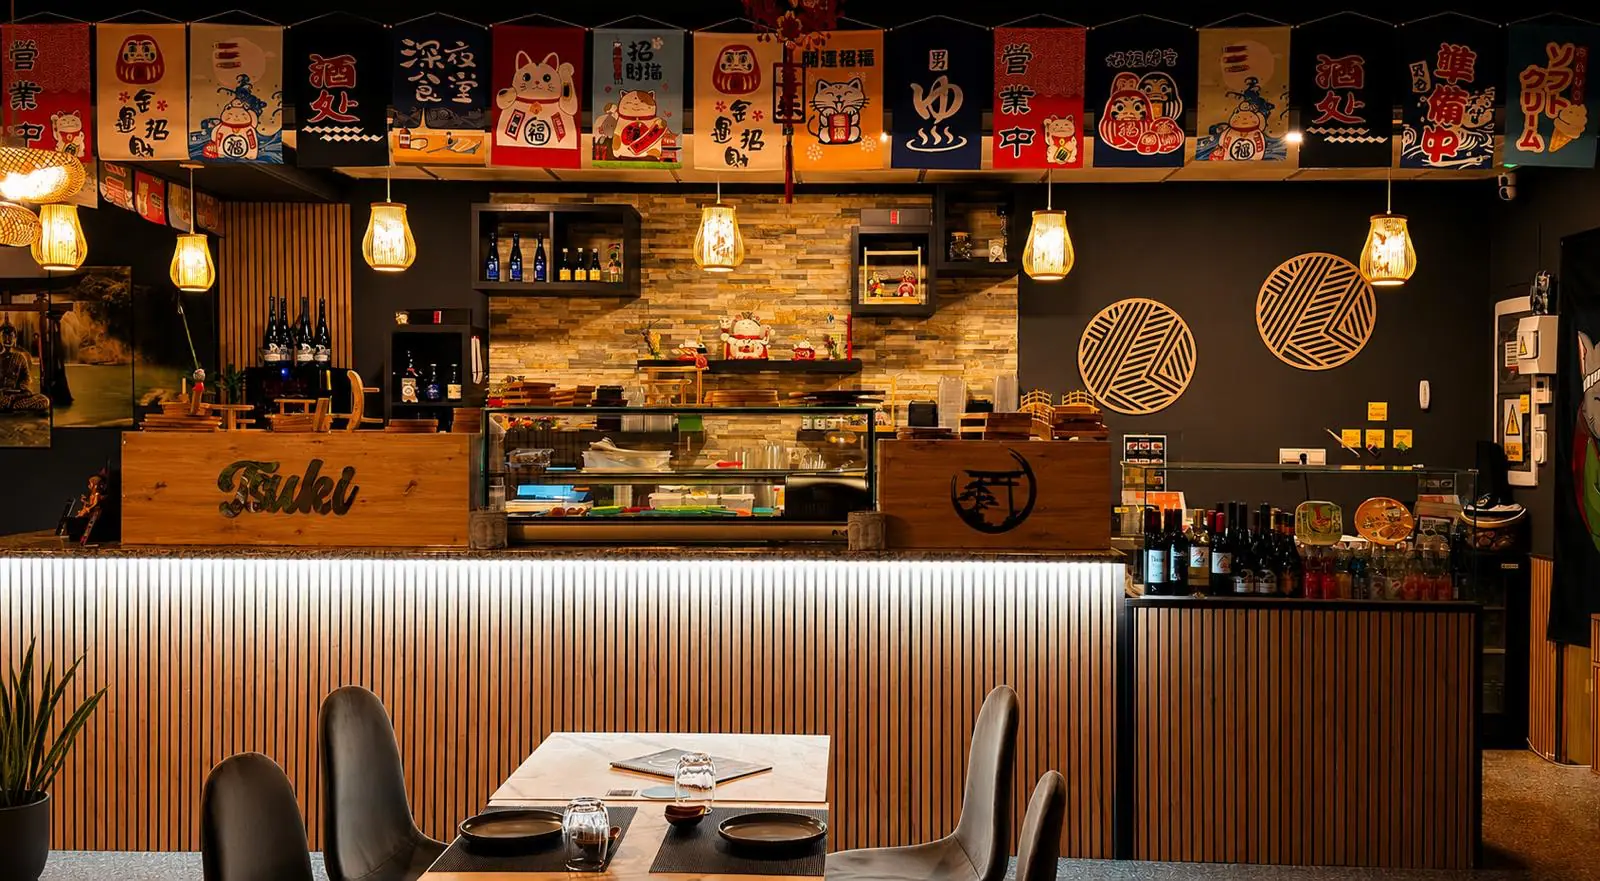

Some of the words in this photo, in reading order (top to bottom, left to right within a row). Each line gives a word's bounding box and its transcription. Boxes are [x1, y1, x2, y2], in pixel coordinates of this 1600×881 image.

[400, 37, 476, 70] 深夜
[929, 50, 948, 70] 男
[408, 71, 478, 103] 食堂
[910, 75, 964, 125] ゆ
[1421, 42, 1477, 163] 準備中
[1545, 42, 1575, 119] ソフト
[528, 123, 545, 141] 福
[1516, 64, 1546, 153] クリーム
[217, 458, 360, 518] Tsuki
